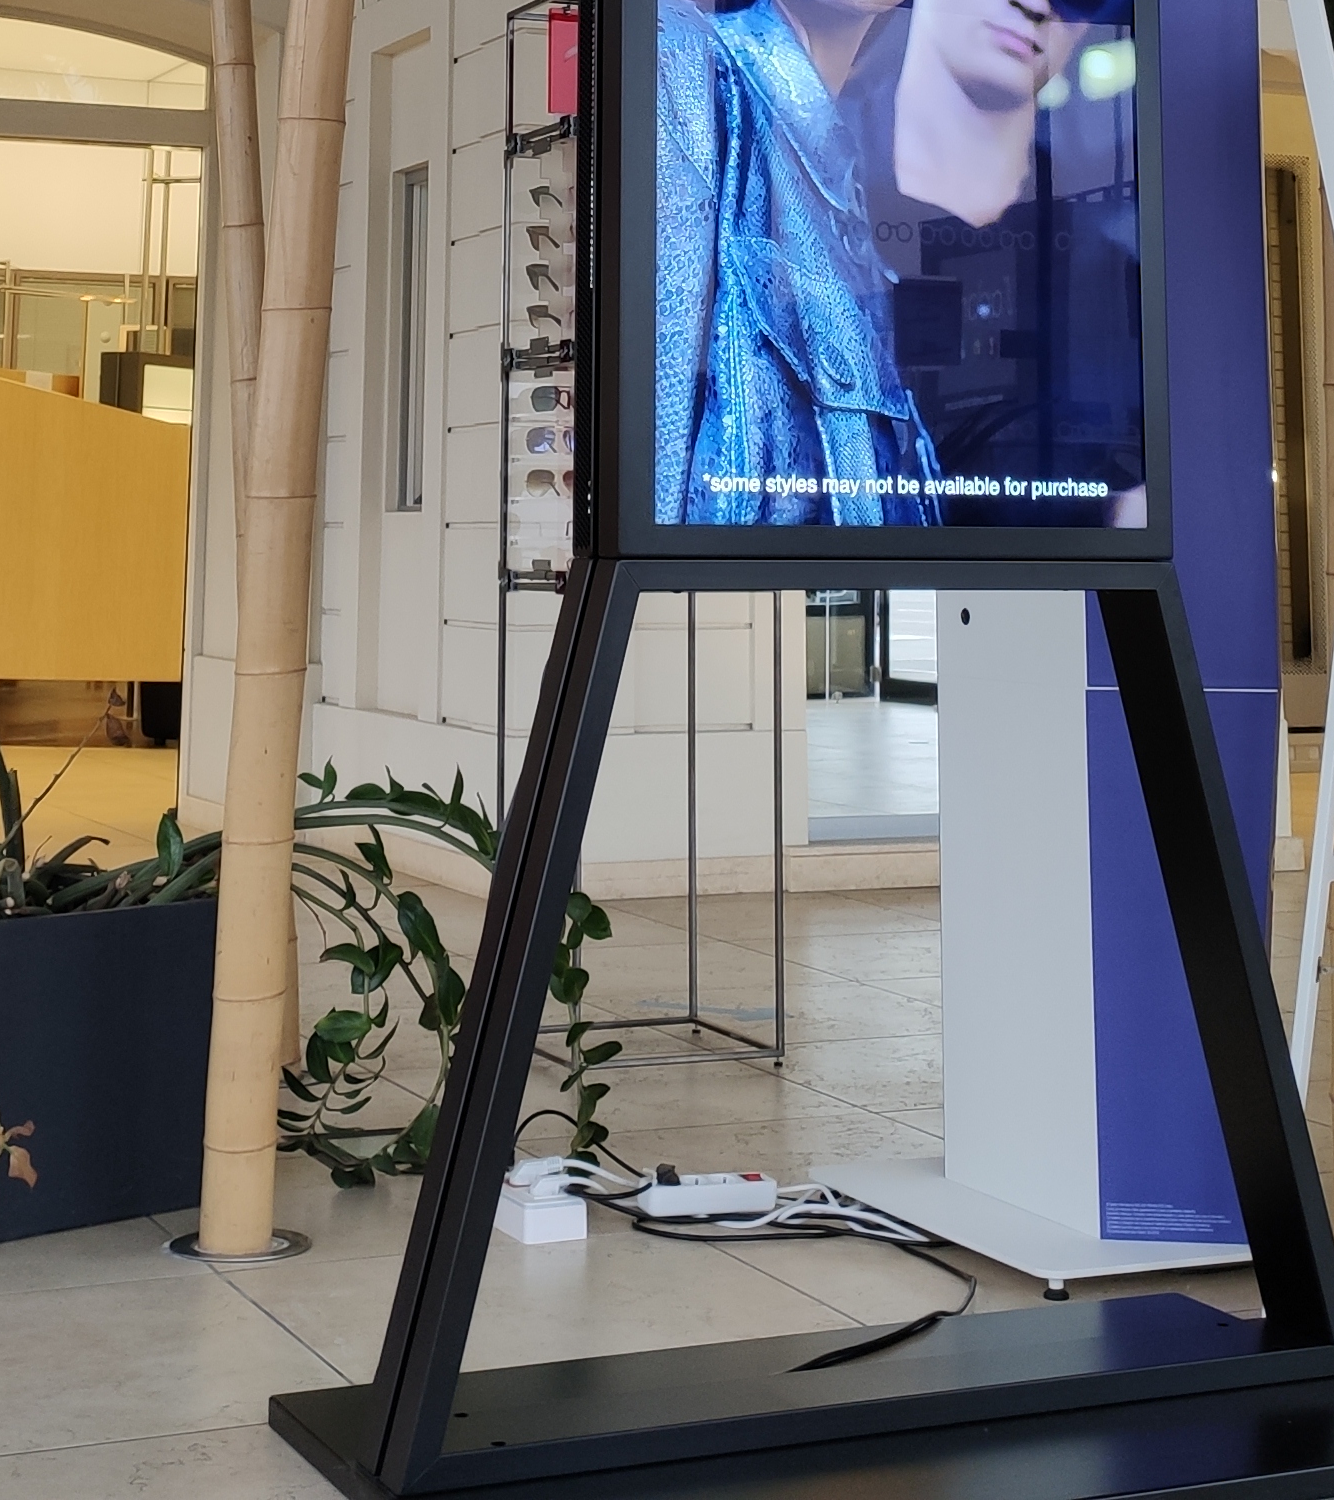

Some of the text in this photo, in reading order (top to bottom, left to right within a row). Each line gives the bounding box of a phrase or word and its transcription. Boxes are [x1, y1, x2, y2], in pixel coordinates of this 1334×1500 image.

[765, 473, 818, 497] styles
[822, 477, 861, 498] may
[865, 475, 894, 494] not
[897, 474, 920, 495] be
[924, 475, 1001, 496] available
[1003, 476, 1028, 496] for
[1031, 477, 1109, 500] purchase
